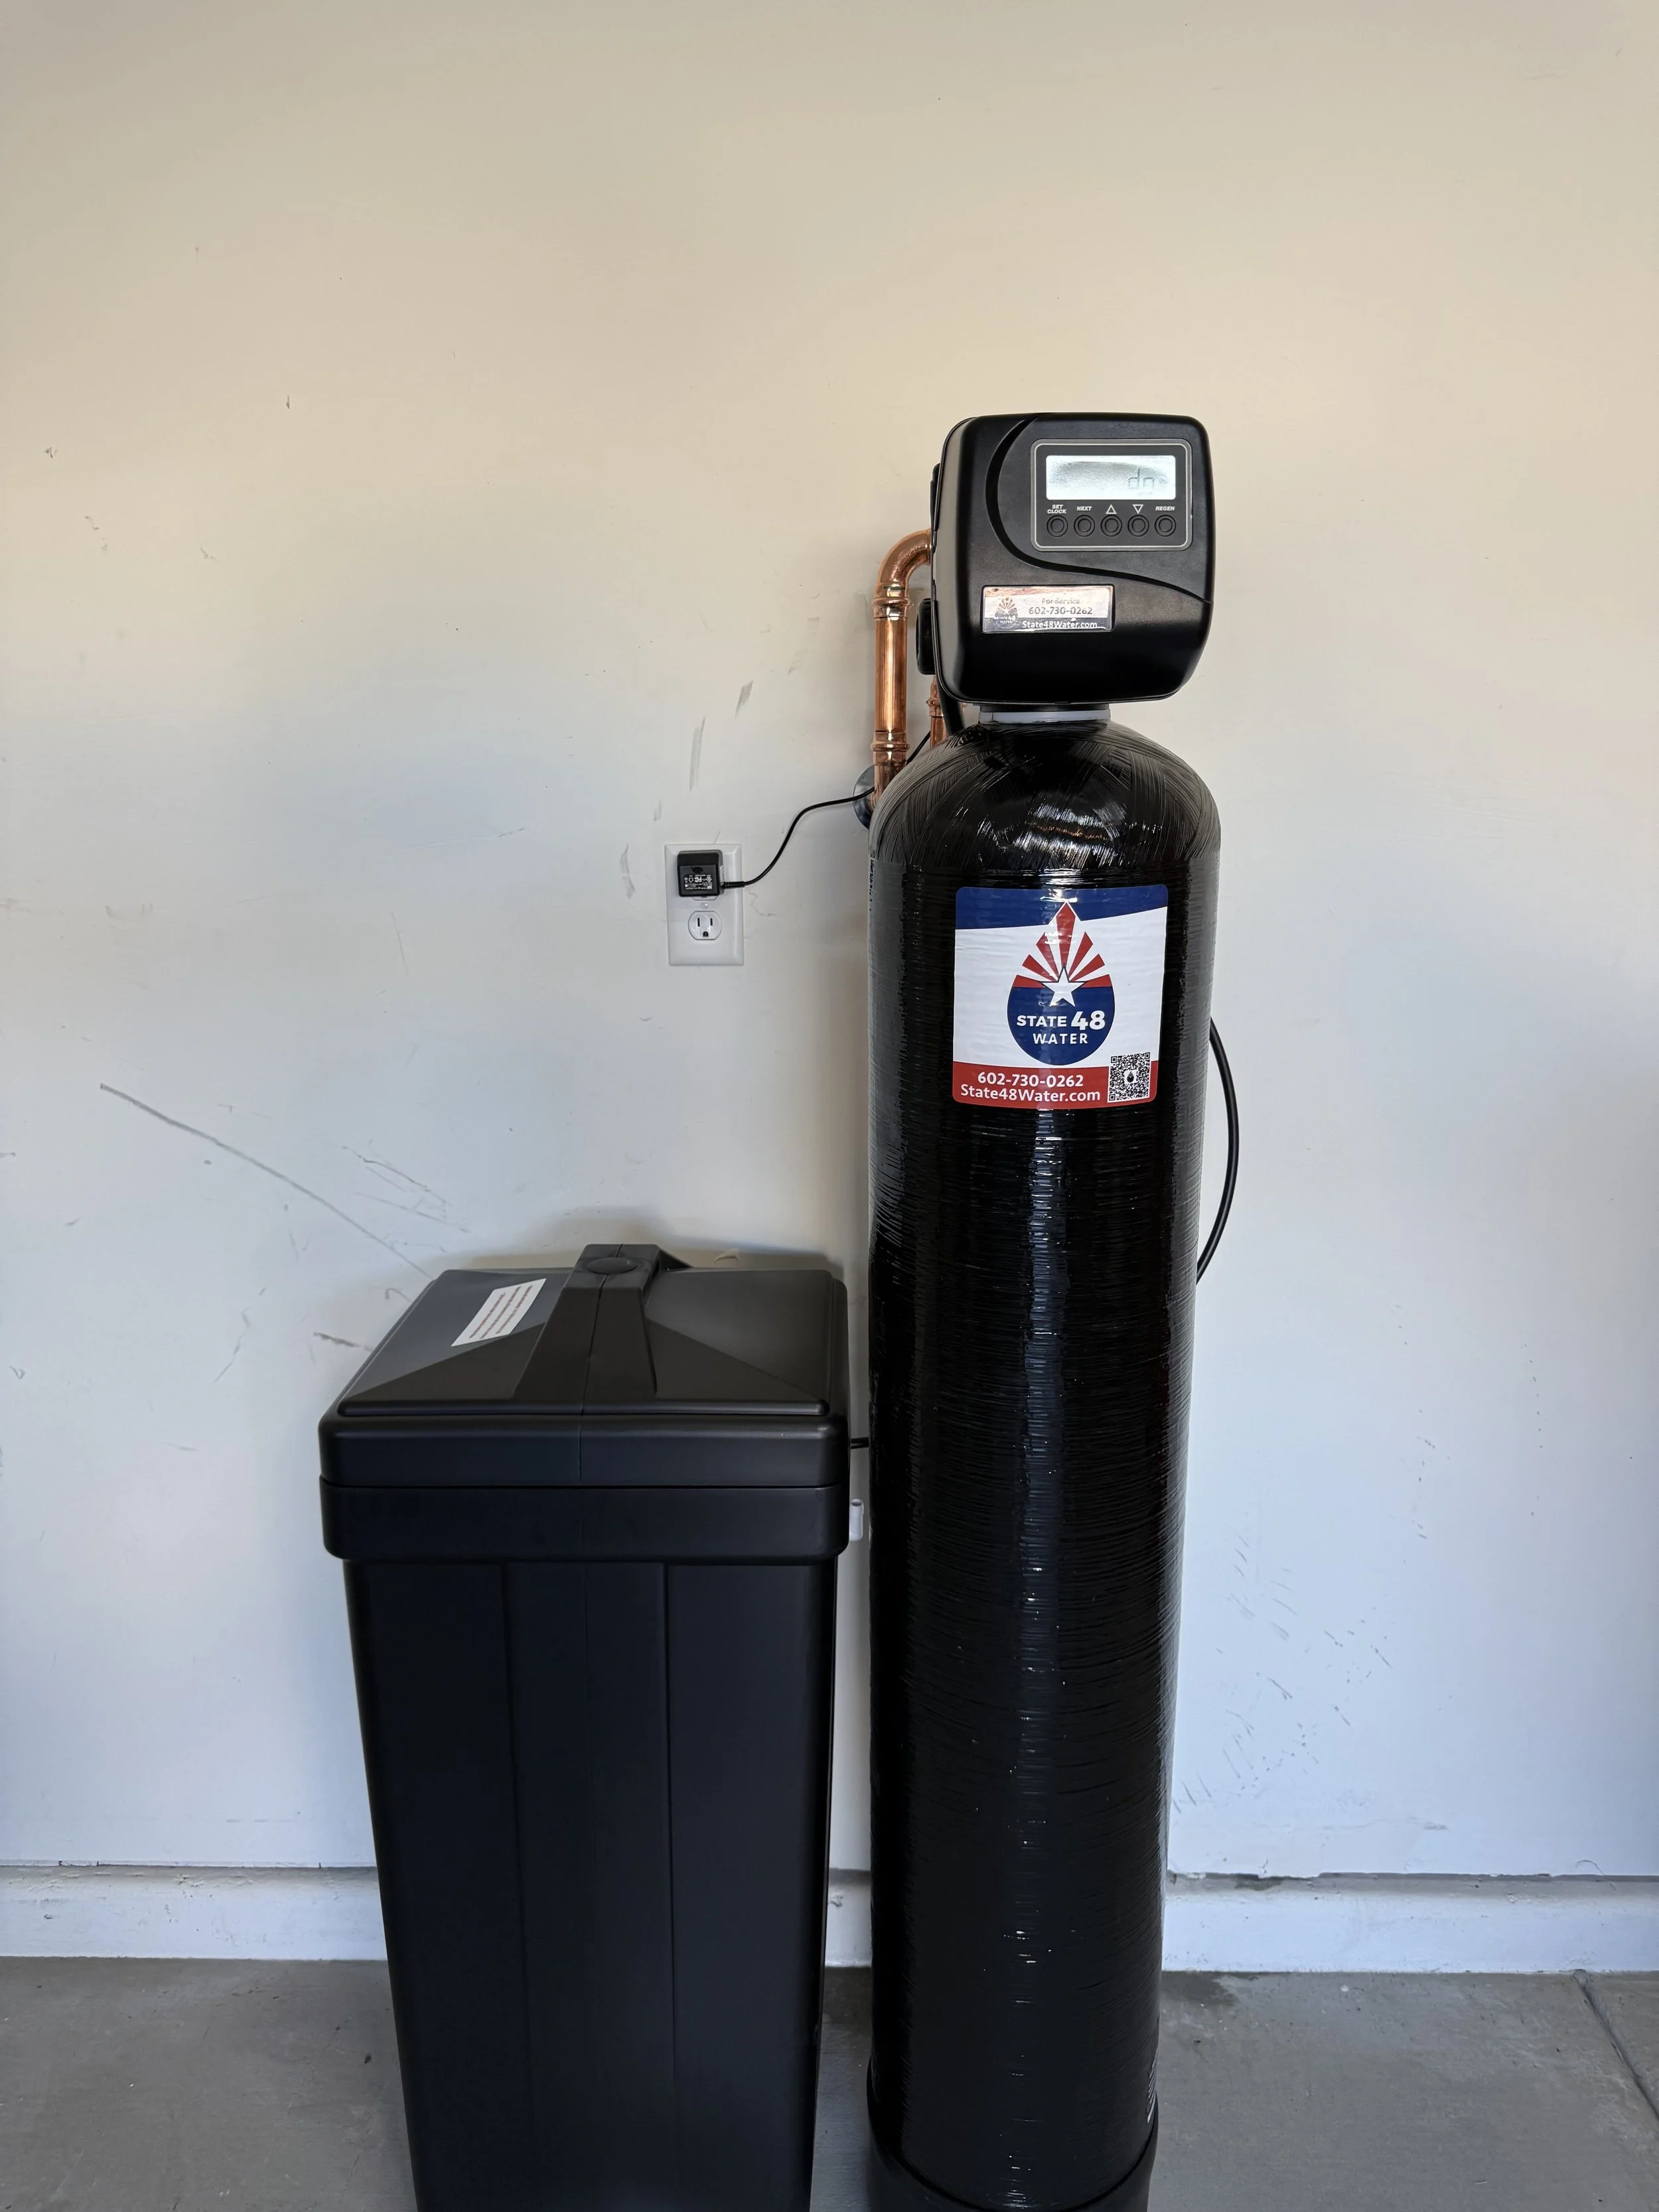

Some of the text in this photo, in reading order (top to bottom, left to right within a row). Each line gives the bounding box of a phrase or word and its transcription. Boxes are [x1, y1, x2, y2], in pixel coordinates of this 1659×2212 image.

[1022, 620, 1098, 628] State48Water.com
[1016, 1011, 1106, 1030] STATE 48
[1033, 1033, 1088, 1045] WATER
[977, 1072, 1084, 1088] 602-730-0262
[960, 1084, 1101, 1102] State48Water.com
